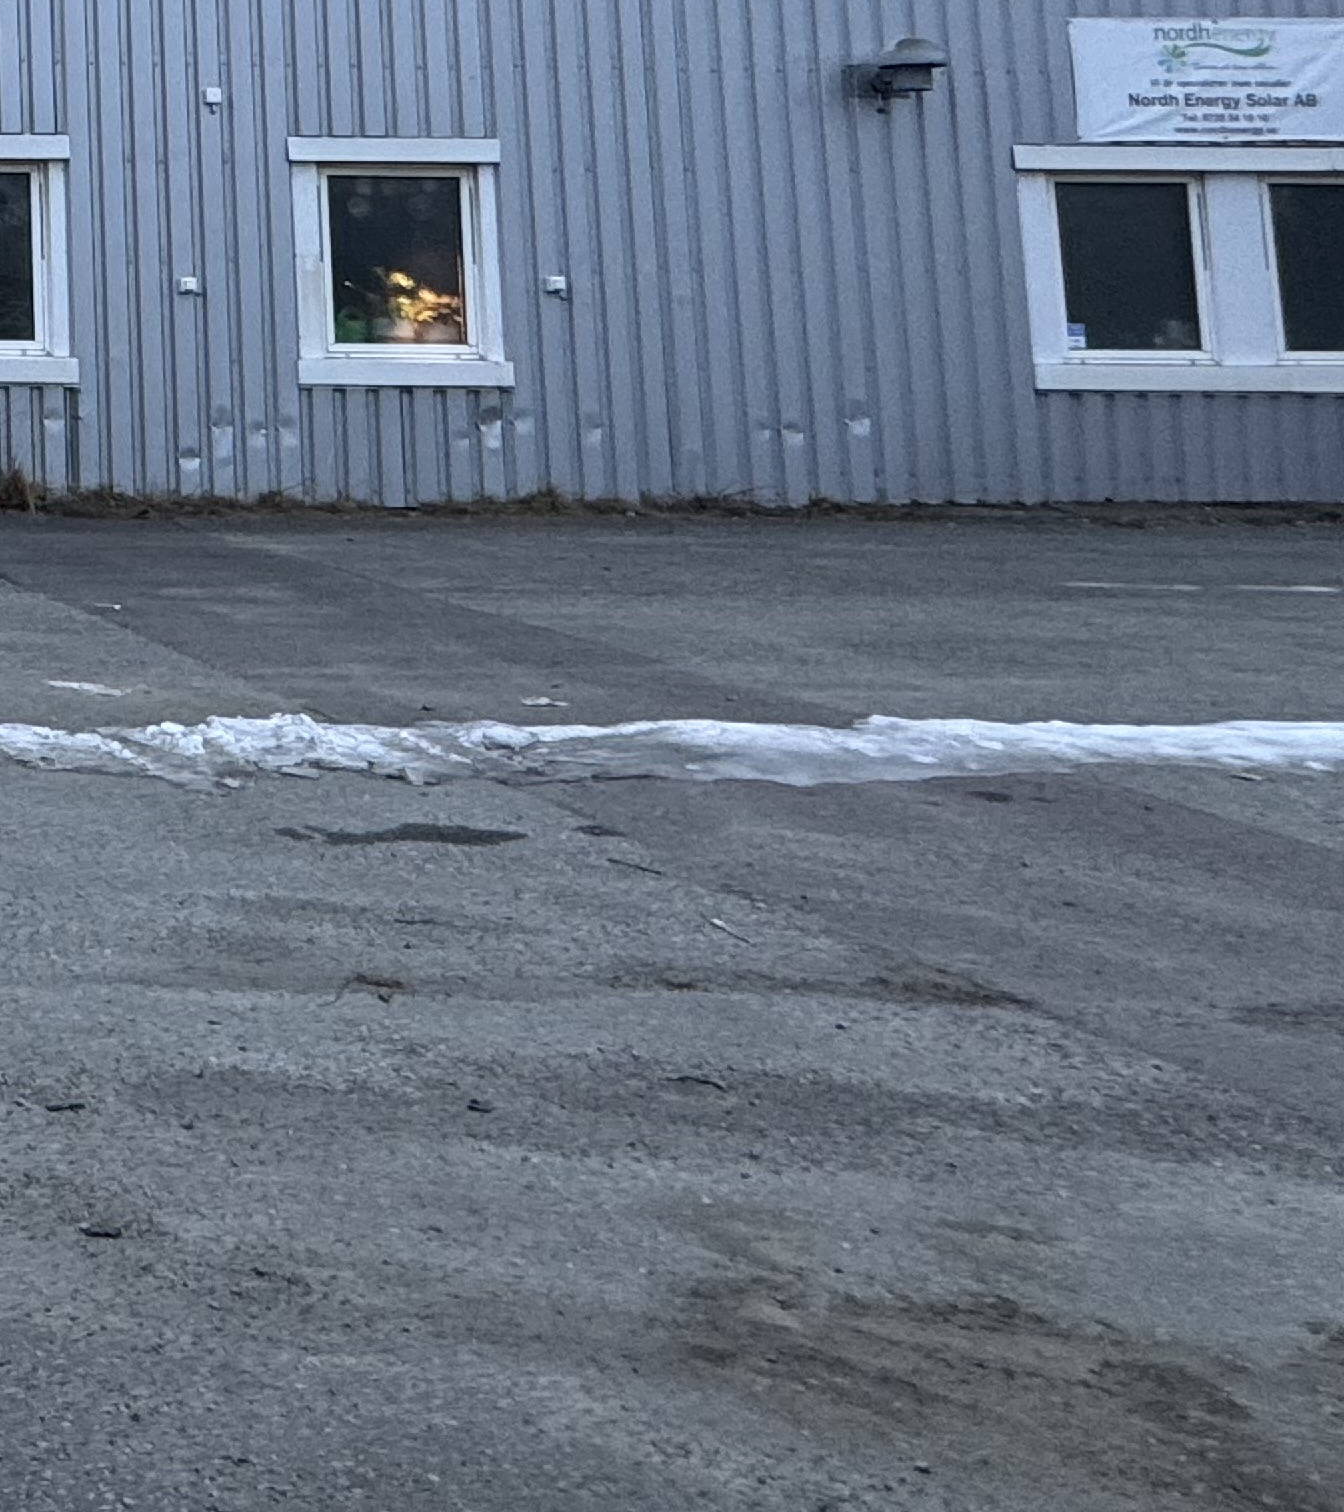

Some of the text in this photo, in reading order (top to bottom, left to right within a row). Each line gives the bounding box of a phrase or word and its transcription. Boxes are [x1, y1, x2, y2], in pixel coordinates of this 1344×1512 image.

[1128, 93, 1318, 109] Nordh Energy Solar AB
